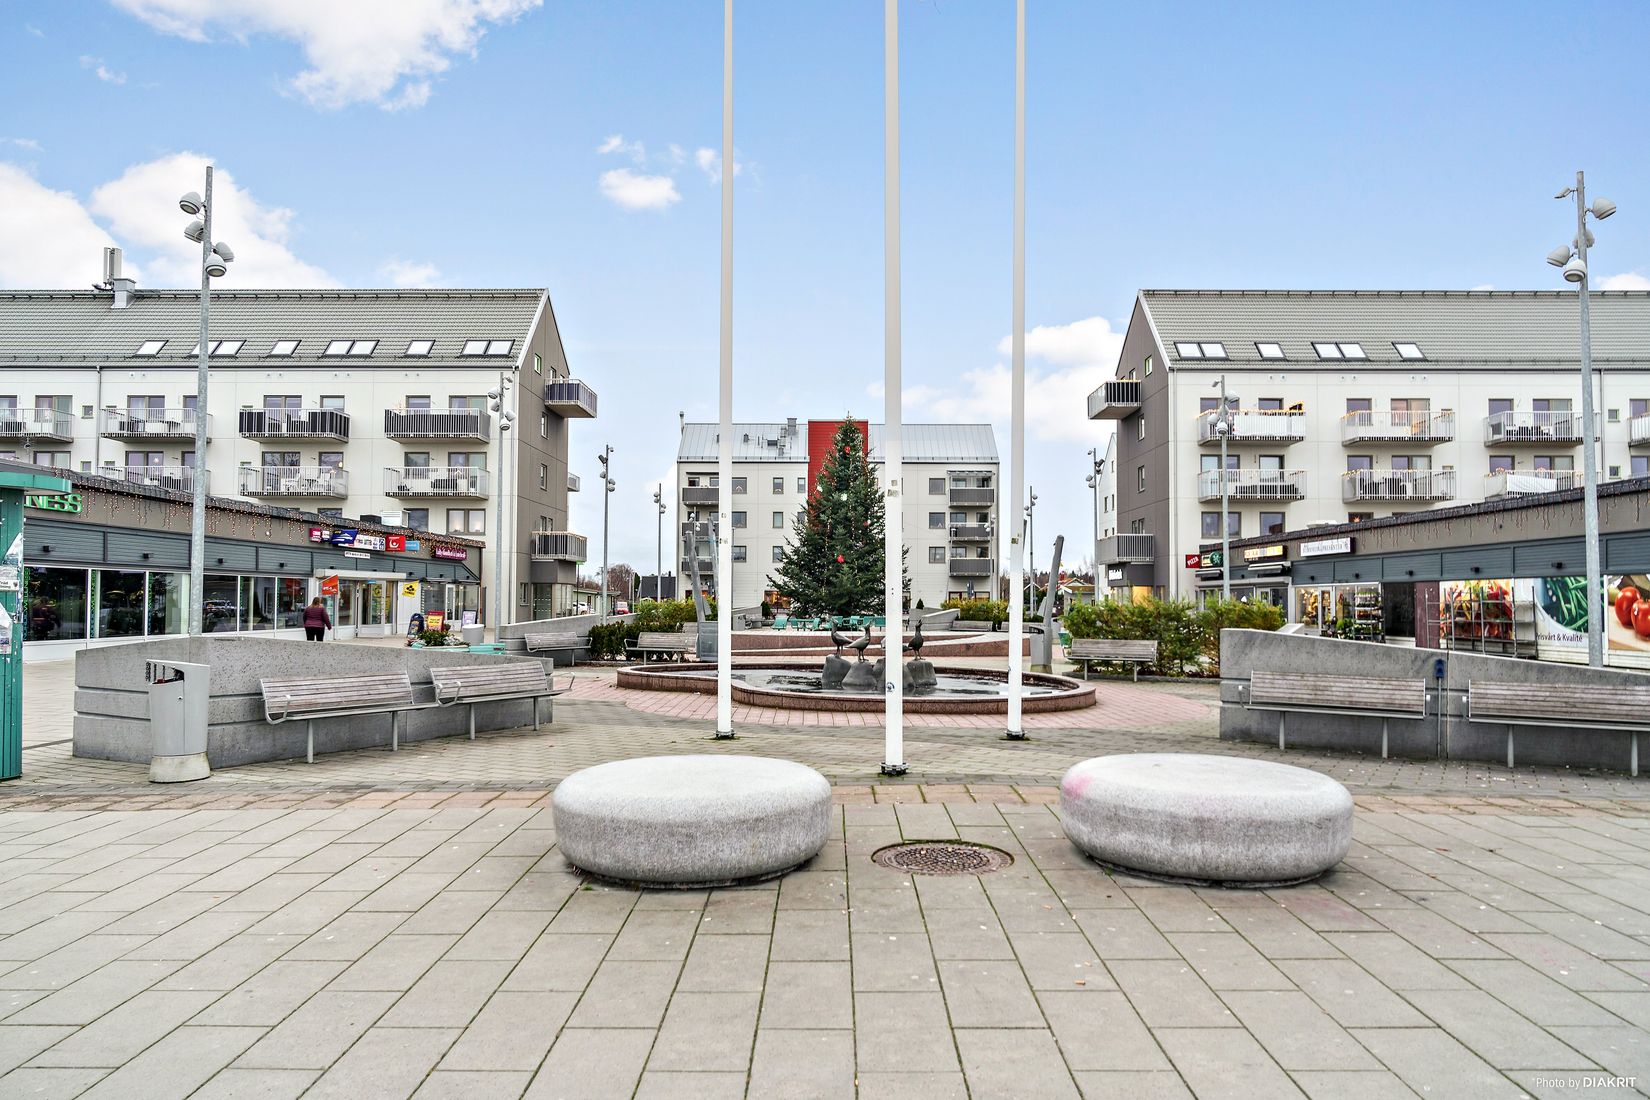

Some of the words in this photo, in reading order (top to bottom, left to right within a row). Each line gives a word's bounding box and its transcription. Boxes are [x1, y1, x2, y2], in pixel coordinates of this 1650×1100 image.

[24, 493, 83, 513] NESS
[1187, 556, 1199, 566] PIZZA
[1557, 633, 1562, 641] &
